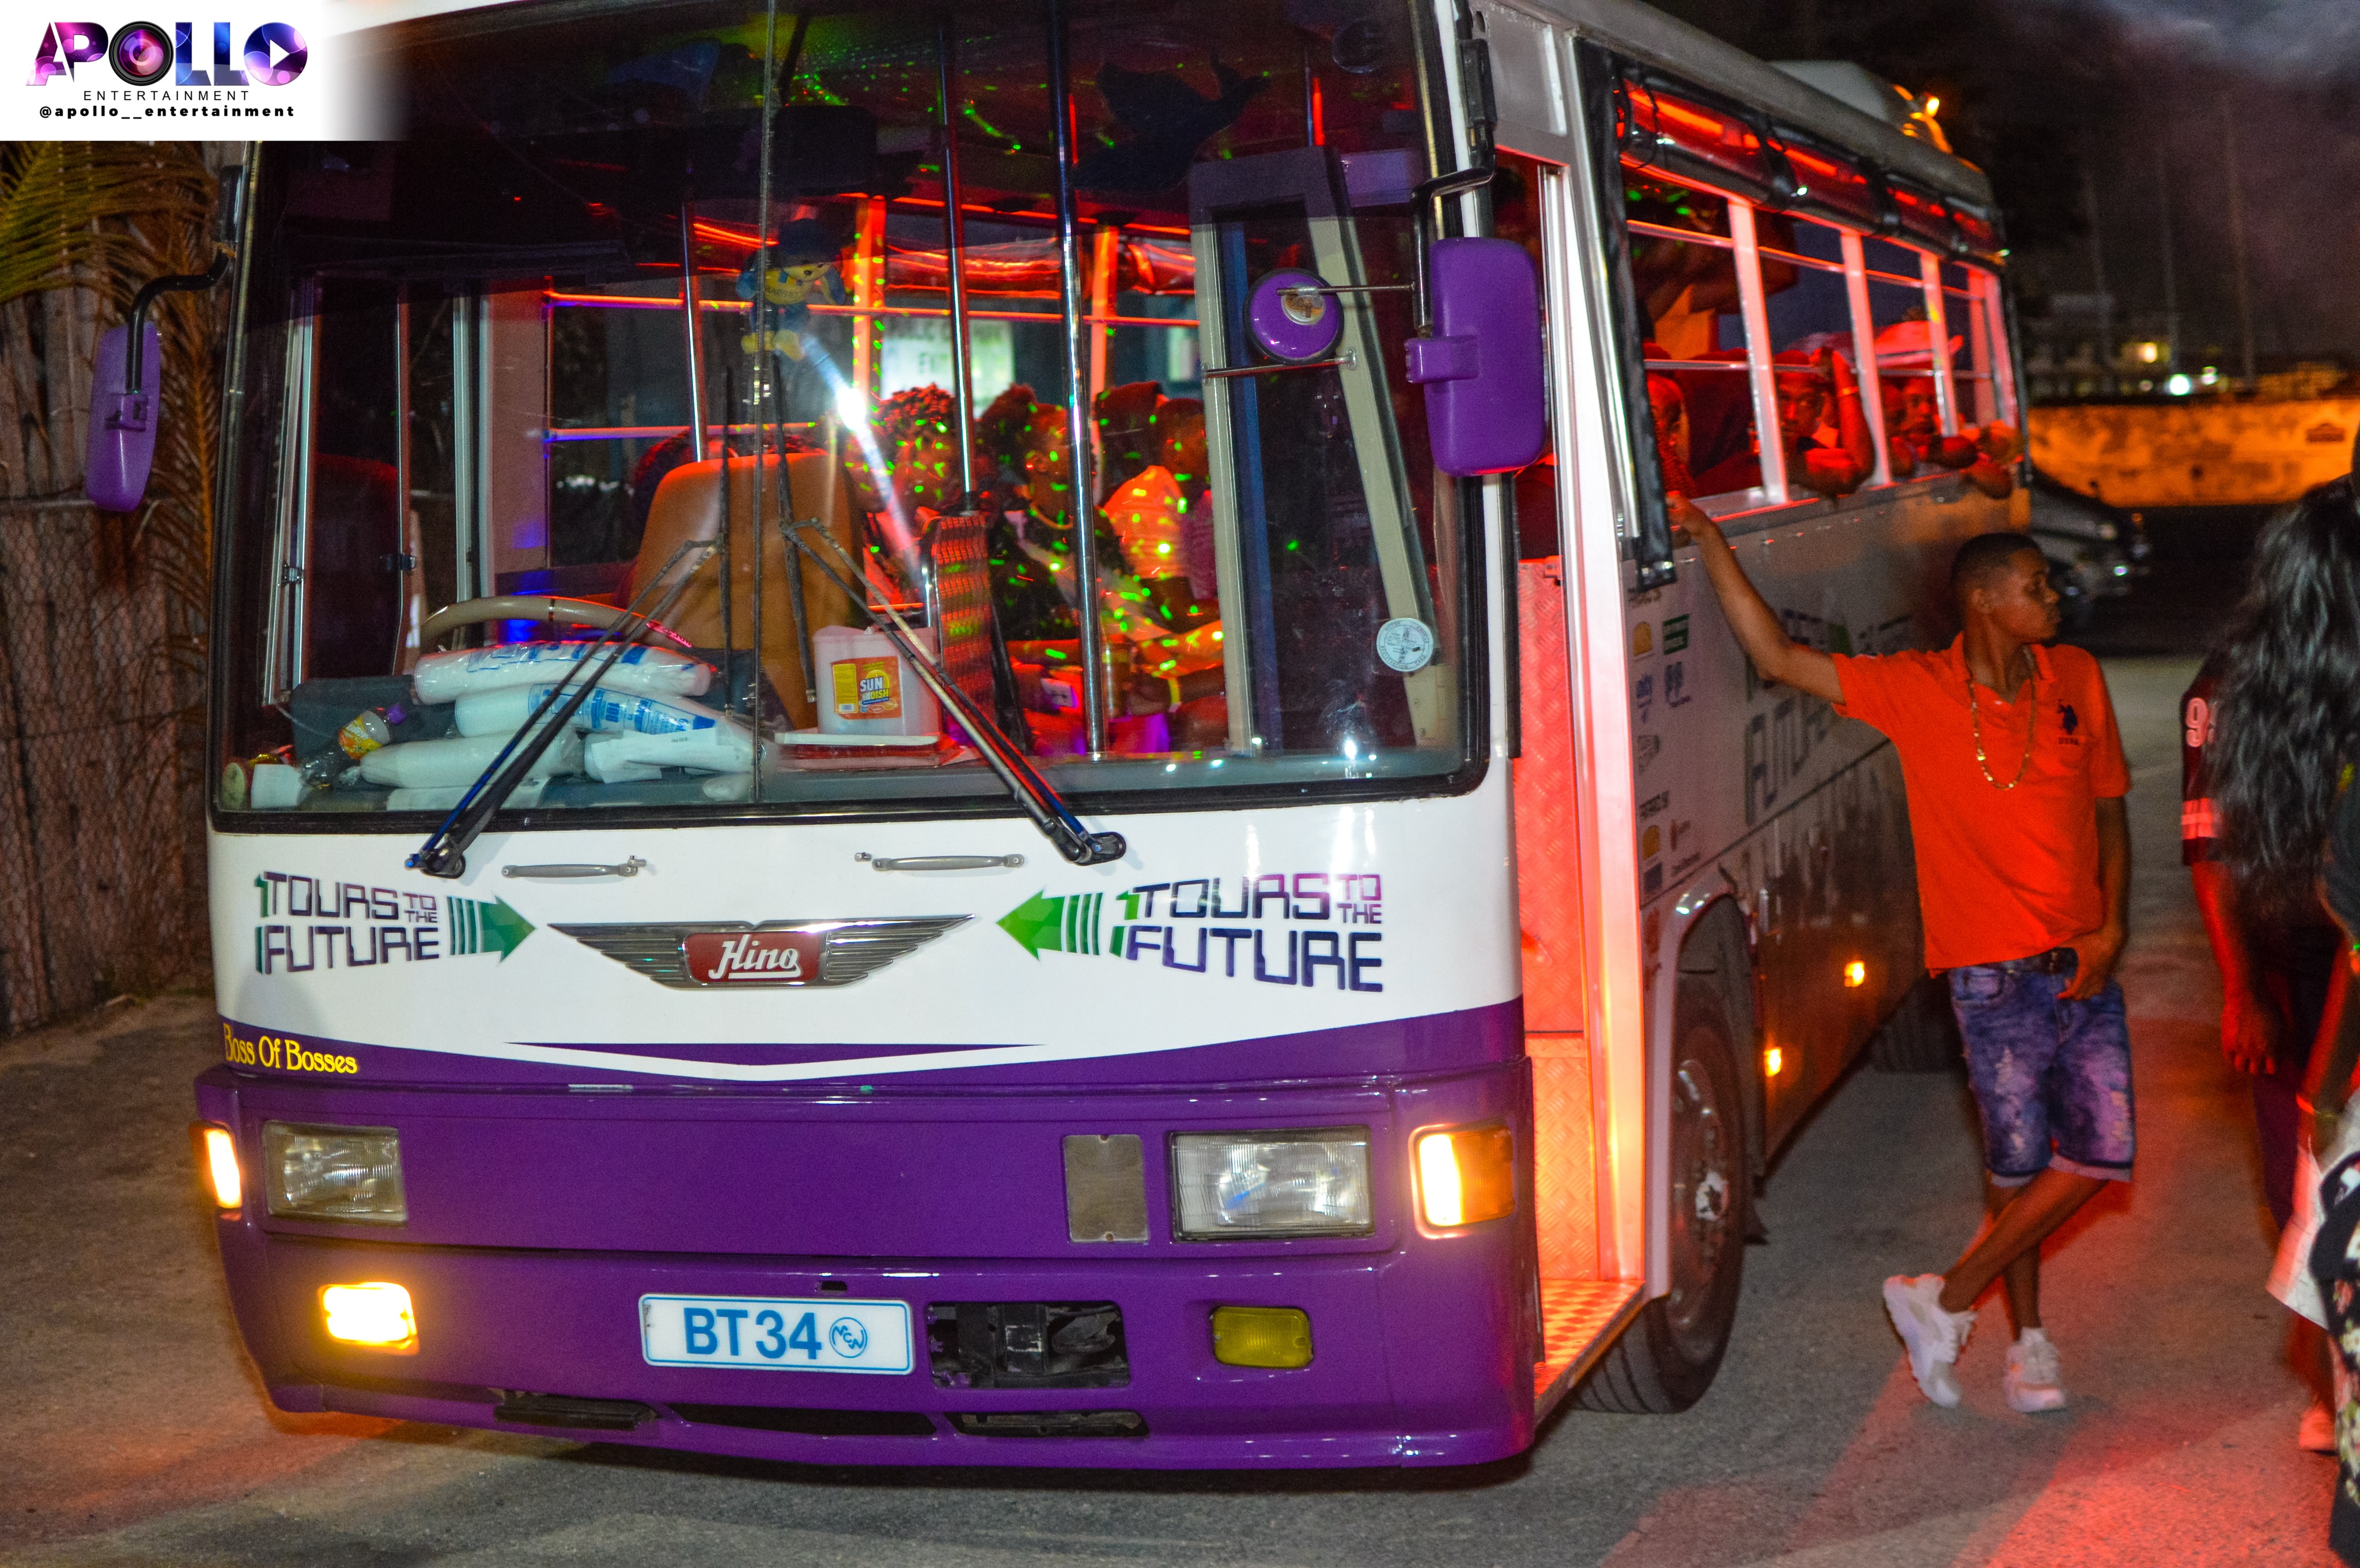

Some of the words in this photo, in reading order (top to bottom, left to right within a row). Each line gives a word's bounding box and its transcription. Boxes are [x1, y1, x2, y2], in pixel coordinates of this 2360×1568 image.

[860, 677, 883, 692] SUN
[871, 689, 889, 699] DISH
[403, 892, 437, 911] TO
[1336, 873, 1382, 902] TO
[404, 910, 438, 923] THE
[1337, 903, 1382, 924] THE
[265, 925, 440, 975] FUTURE
[708, 934, 801, 979] Hino
[1125, 925, 1383, 993] FUTURE
[259, 1036, 281, 1069] Of
[285, 1039, 358, 1074] Bosses
[683, 1307, 822, 1360] BT34
